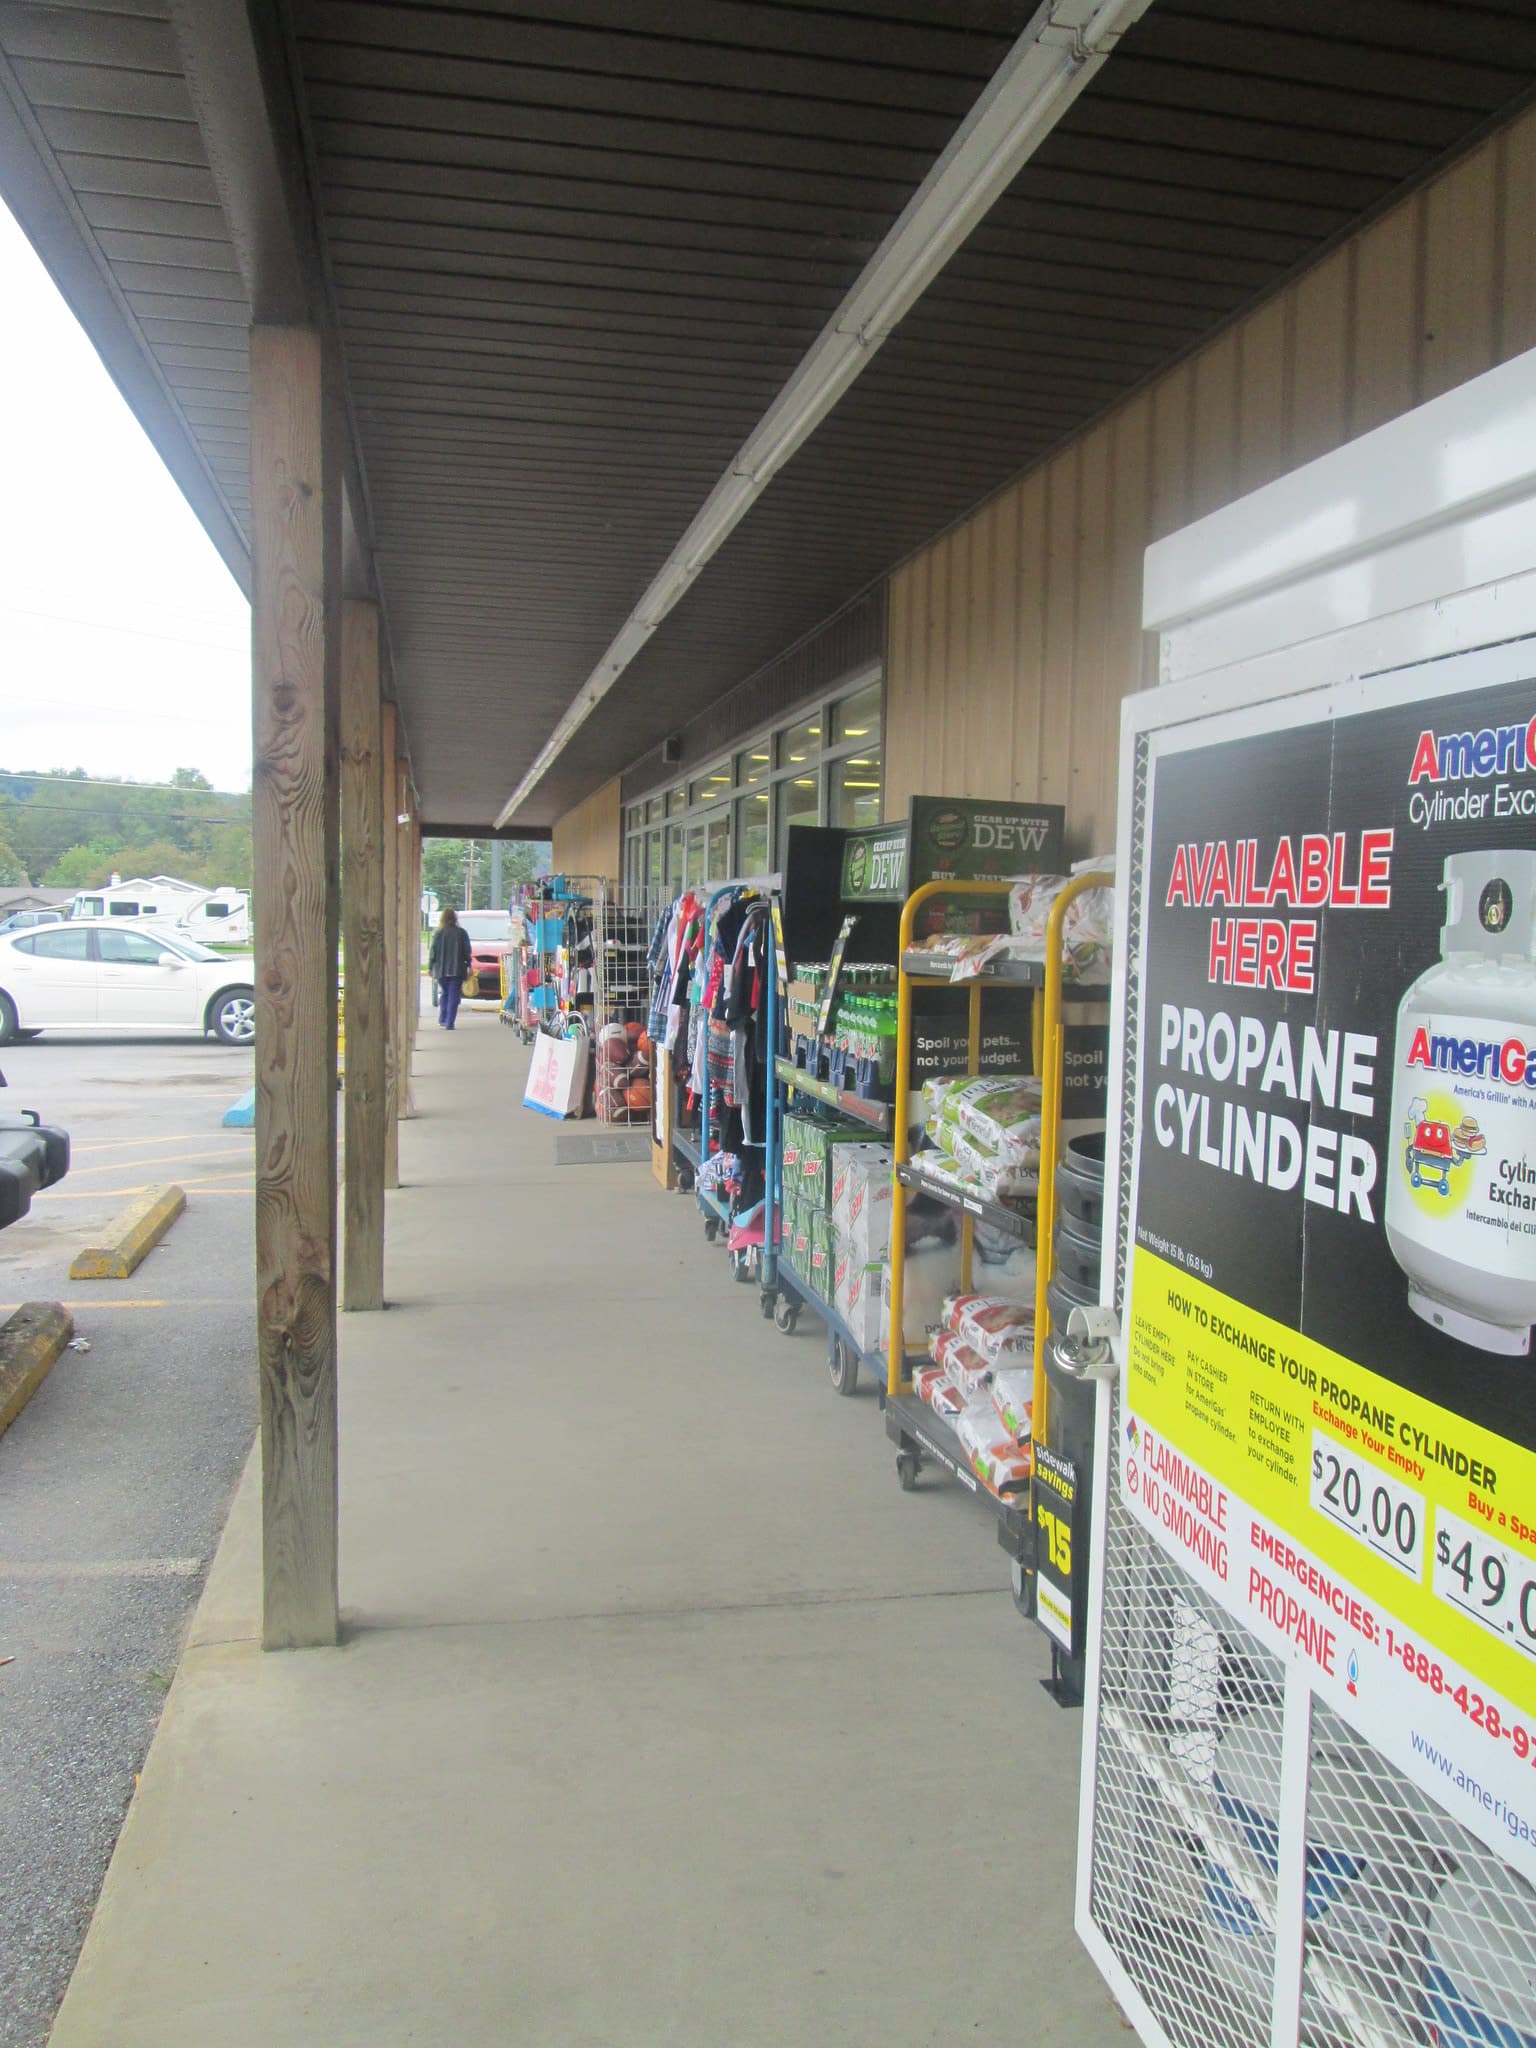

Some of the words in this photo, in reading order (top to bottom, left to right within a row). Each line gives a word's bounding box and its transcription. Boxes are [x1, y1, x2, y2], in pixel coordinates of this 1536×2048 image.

[973, 815, 1003, 824] GEAR
[1004, 817, 1019, 825] UP
[1020, 818, 1049, 827] WITH
[1409, 787, 1490, 830] Cylinder
[1494, 783, 1536, 817] Exc
[972, 823, 1049, 852] DEW
[870, 851, 905, 889] DEW
[1165, 828, 1395, 909] AVAILABLE
[1208, 918, 1317, 994] HERE
[916, 1037, 950, 1050] Spoil
[916, 1055, 939, 1066] not
[979, 1053, 1021, 1065] udget.
[1064, 1051, 1103, 1065] Spoil
[1160, 1003, 1378, 1117] PROPANE
[1065, 1074, 1089, 1087] not
[1453, 1084, 1485, 1100] America's
[1486, 1090, 1511, 1104] Grillin'
[1512, 1096, 1528, 1108] with
[1154, 1083, 1377, 1223] CYLINDER
[1466, 1209, 1508, 1230] Intercambio
[1509, 1220, 1521, 1232] del
[1148, 1231, 1170, 1254] Weight
[1200, 1259, 1213, 1279] kg)
[1134, 1330, 1160, 1356] CYLINDER
[1160, 1347, 1176, 1367] HERE
[1135, 1314, 1152, 1332] LEAVE
[1152, 1325, 1171, 1345] EMPTY
[1150, 1354, 1165, 1377] bring
[1187, 1350, 1200, 1365] PAY
[1200, 1357, 1228, 1384] CASHIER
[1187, 1368, 1193, 1378] IN
[1195, 1371, 1215, 1393] STORE
[1167, 1289, 1192, 1318] HOW
[1195, 1305, 1208, 1328] TO
[1211, 1316, 1276, 1369] EXCHANGE
[1280, 1352, 1317, 1392] YOUR
[1320, 1376, 1395, 1438] PROPANE
[1400, 1422, 1497, 1495] CYLINDER
[1185, 1383, 1195, 1396] for
[1185, 1400, 1210, 1424] propane
[1210, 1417, 1237, 1443] cylinder.
[1249, 1408, 1291, 1443] EMPLOYEE
[1250, 1390, 1281, 1418] RETURN
[1283, 1410, 1305, 1433] WITH
[1248, 1427, 1257, 1440] to
[1257, 1433, 1295, 1465] exchange
[1312, 1400, 1358, 1440] Exchange
[1361, 1428, 1385, 1456] Your
[1387, 1445, 1426, 1482] Empty
[1036, 1444, 1075, 1483] sidewalk
[1036, 1463, 1074, 1501] savings
[1143, 1430, 1228, 1533] FLAMMABLE
[1247, 1445, 1264, 1462] your
[1265, 1454, 1299, 1487] cylinder.
[1312, 1448, 1416, 1555] $20.00
[1468, 1491, 1495, 1522] Buy
[1497, 1511, 1507, 1527] a
[1037, 1503, 1072, 1576] $15
[1143, 1472, 1160, 1517] NO
[1162, 1491, 1228, 1583] SMOKING
[1250, 1520, 1380, 1647] EMERGENCIES:
[1249, 1565, 1337, 1678] PROPANE
